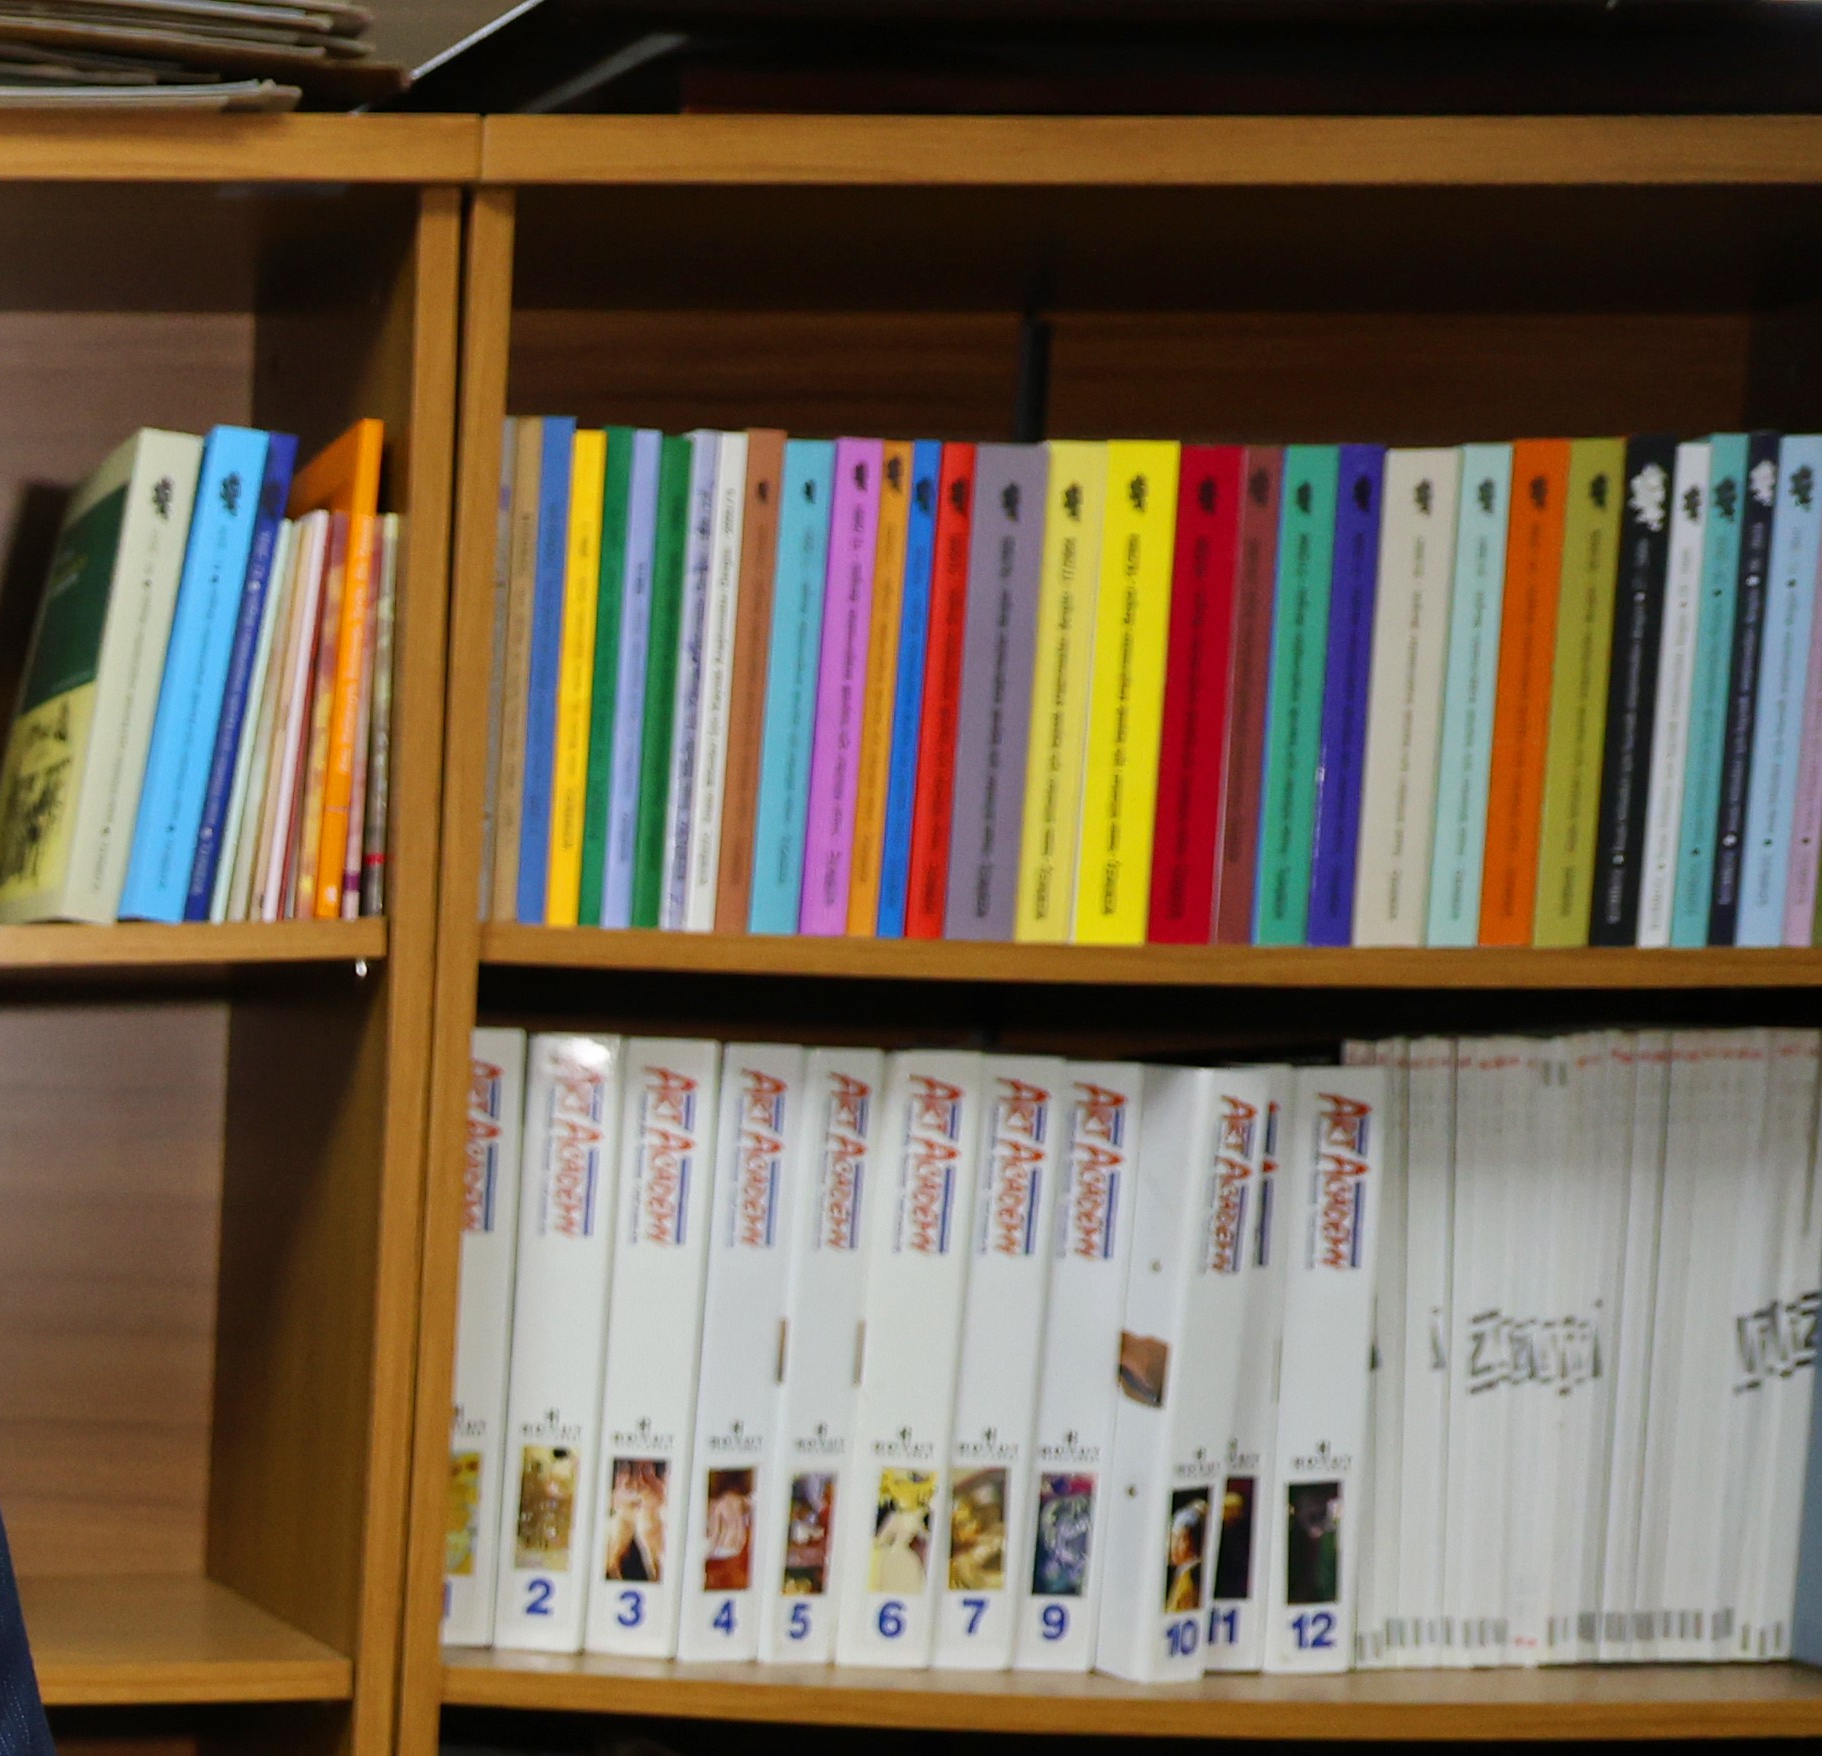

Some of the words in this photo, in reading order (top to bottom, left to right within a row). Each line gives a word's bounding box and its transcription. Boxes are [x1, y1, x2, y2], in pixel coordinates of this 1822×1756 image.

[526, 1578, 555, 1615] 2
[617, 1590, 644, 1627] 3
[713, 1600, 736, 1636] 4
[789, 1603, 812, 1640] 5
[876, 1600, 907, 1639] 6
[962, 1598, 989, 1636] 7
[1043, 1605, 1070, 1641] 9
[1291, 1613, 1336, 1649] 12
[1166, 1620, 1200, 1655] 10
